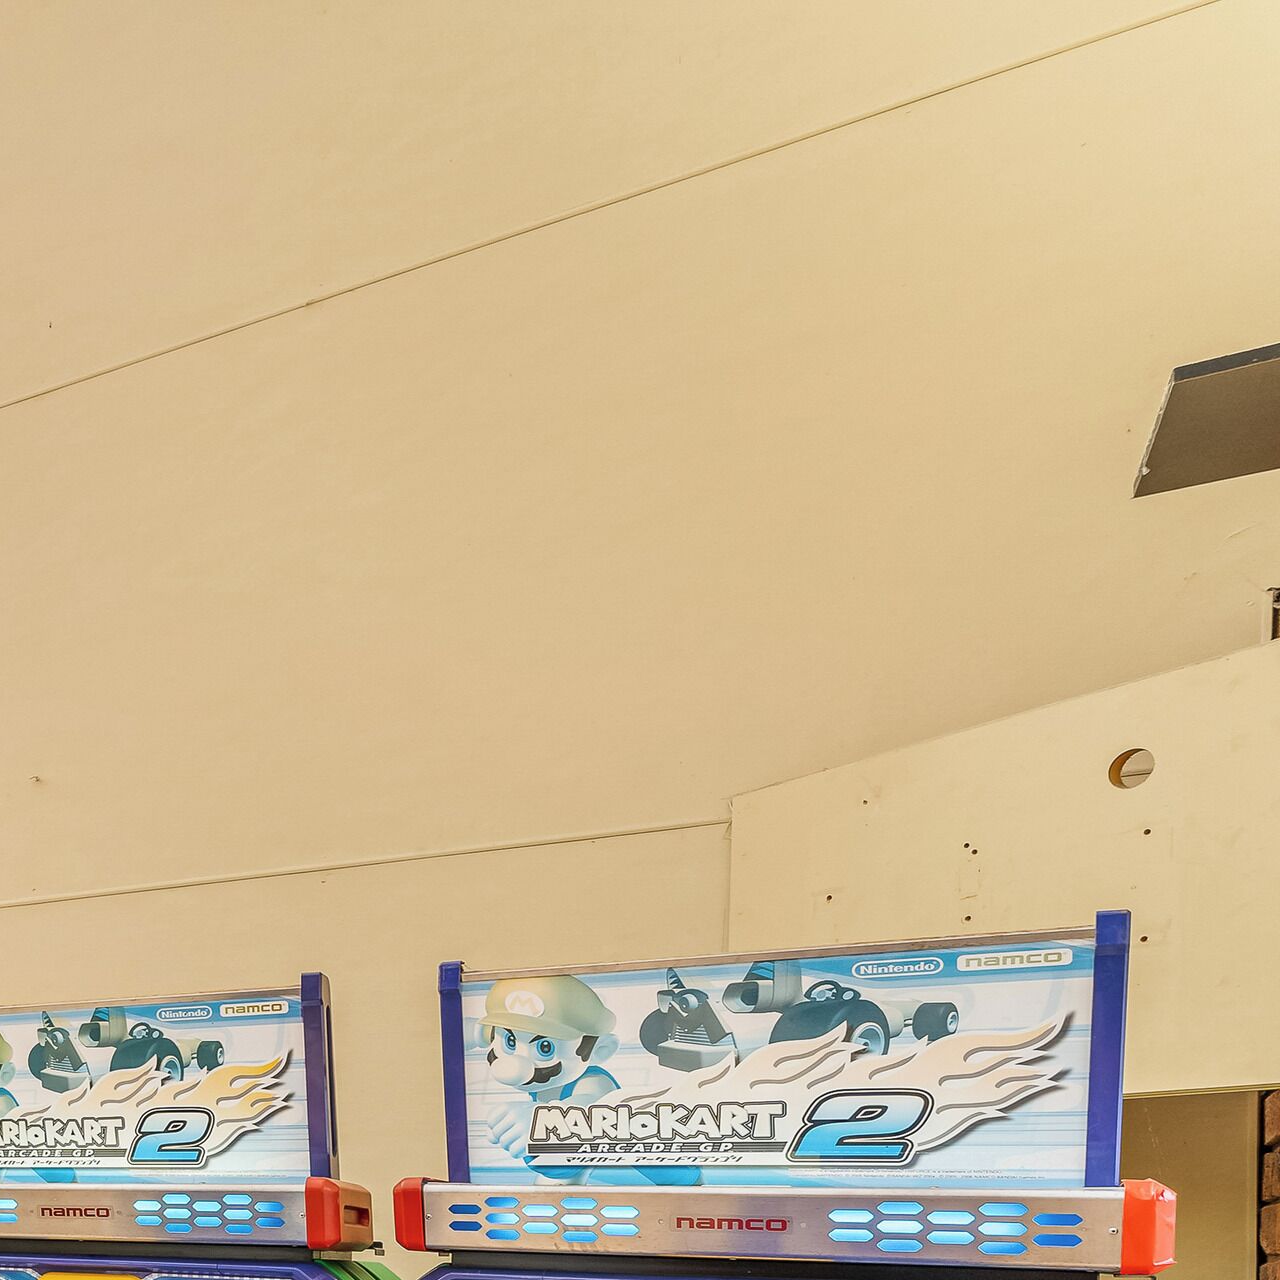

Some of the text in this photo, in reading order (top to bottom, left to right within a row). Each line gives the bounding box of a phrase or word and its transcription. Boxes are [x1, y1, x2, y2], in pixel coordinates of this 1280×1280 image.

[964, 952, 1064, 968] namco
[859, 961, 935, 975] Nintendo
[161, 1008, 209, 1019] Nintendo
[224, 1001, 283, 1015] namco
[789, 1088, 933, 1166] 2
[128, 1107, 214, 1165] 2
[69, 1150, 95, 1158] GP
[578, 1142, 734, 1153] ARCADE GP
[41, 1206, 111, 1218] namco
[675, 1213, 790, 1233] namco
